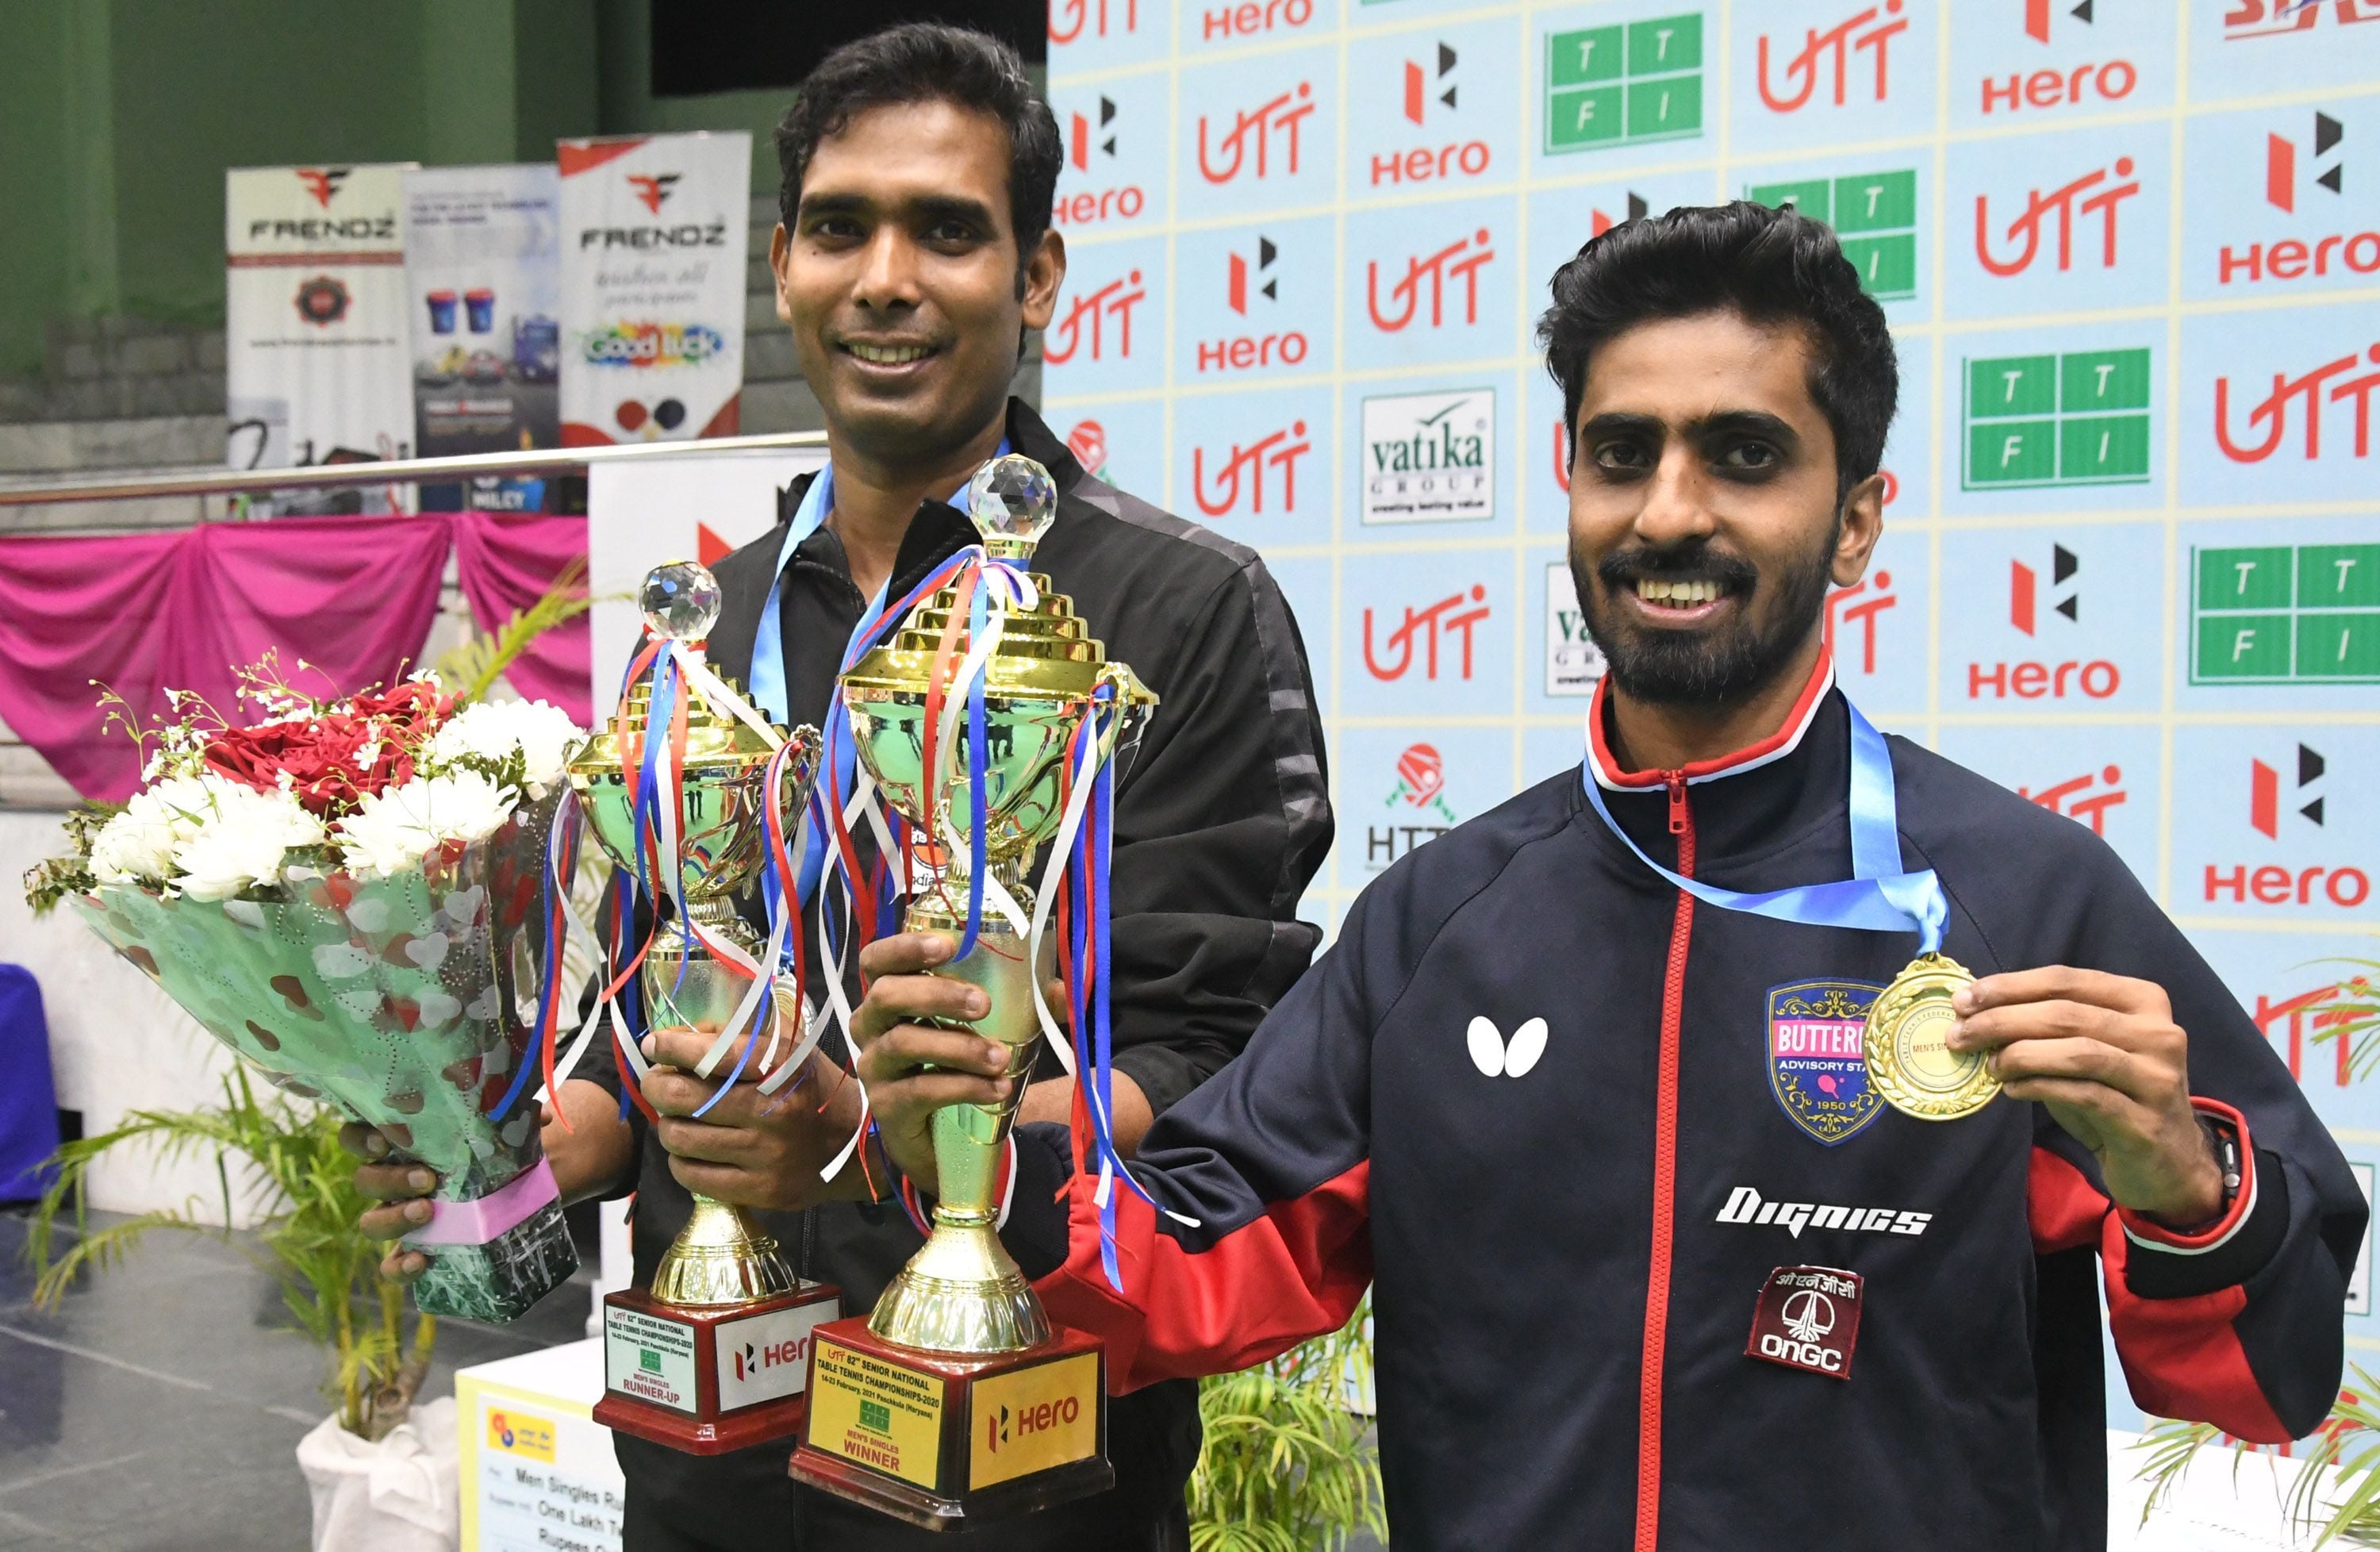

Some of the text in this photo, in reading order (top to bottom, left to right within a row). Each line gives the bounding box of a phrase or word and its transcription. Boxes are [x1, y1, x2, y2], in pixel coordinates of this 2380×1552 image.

[1203, 0, 1312, 40] Hero
[1757, 0, 1909, 113] UTT
[1982, 60, 2136, 113] Hero
[1198, 81, 1315, 184] UTT
[1371, 141, 1490, 186] Hero
[1975, 156, 2140, 277] UTT
[2220, 232, 2380, 283] Hero
[1367, 228, 1494, 332] UTT
[1197, 332, 1307, 371] Hero
[1372, 421, 1483, 472] vatika
[1193, 421, 1310, 517] UTT
[1363, 584, 1490, 682] UTT
[1968, 659, 2120, 698] Hero
[2204, 864, 2370, 908] Hero
[1778, 1024, 1864, 1054] BUTTER
[1779, 1060, 1844, 1071] ADVISORY
[1818, 1101, 1846, 1110] 1950
[608, 1320, 622, 1331] TABLE
[623, 1324, 640, 1335] TENNIS
[638, 1317, 658, 1329] SENIOR
[658, 1323, 685, 1336] NATIONAL
[764, 1337, 808, 1368] Her
[624, 1378, 680, 1404] RUNNER-UP
[649, 1377, 670, 1389] SINGLES
[817, 1358, 939, 1409] TABLE TENNIS CHAMPIONSHIPS-2020
[862, 1360, 889, 1377] SENIOR
[892, 1370, 930, 1391] NATIONAL
[821, 1374, 835, 1385] 14-23
[836, 1379, 862, 1396] February,
[862, 1389, 875, 1399] 2021
[877, 1392, 904, 1410] Panchkula
[905, 1404, 933, 1420] (Haryana)
[1019, 1396, 1079, 1436] Hero
[843, 1439, 900, 1472] WINNER
[846, 1429, 868, 1443] MEN'S
[869, 1438, 899, 1454] SINGLES
[516, 1468, 545, 1489] Men
[548, 1475, 599, 1506] Singles
[538, 1500, 566, 1523] One
[570, 1508, 605, 1531] Lakh
